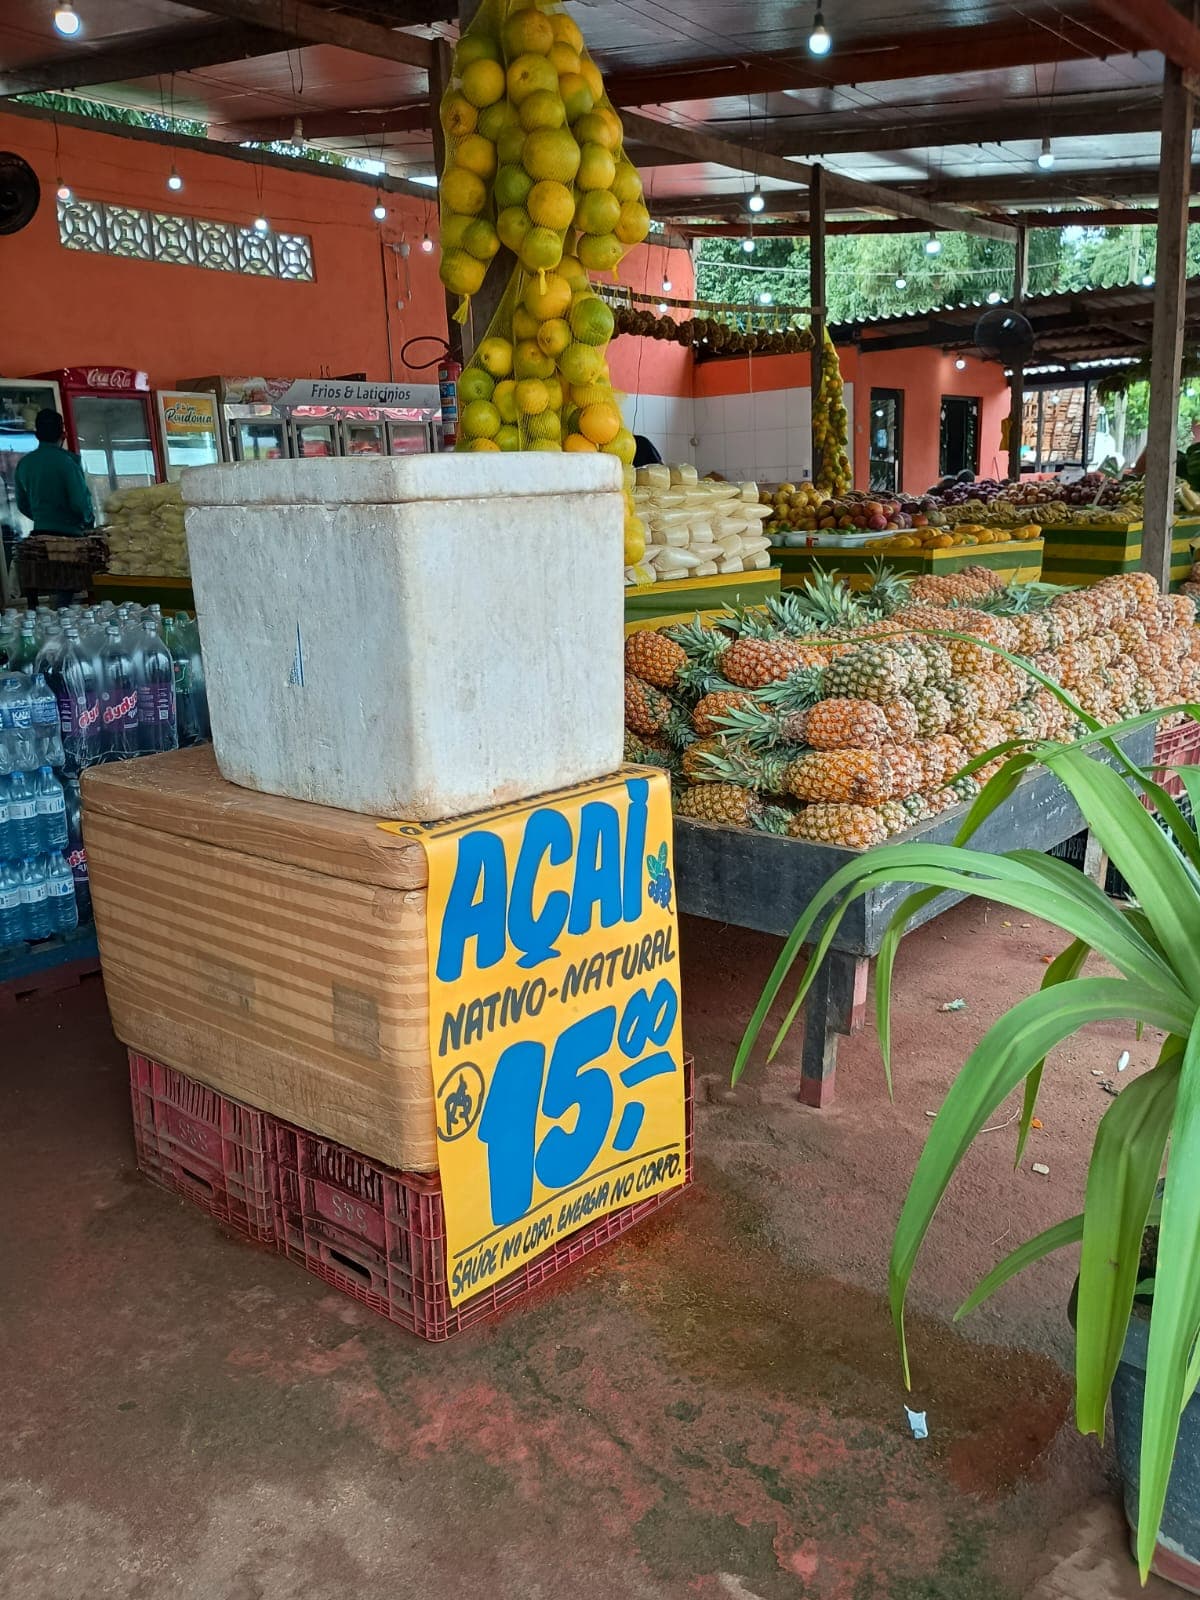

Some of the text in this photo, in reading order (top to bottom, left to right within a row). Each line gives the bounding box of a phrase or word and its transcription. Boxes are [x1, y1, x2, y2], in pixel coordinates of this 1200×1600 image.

[311, 384, 342, 399] Frios
[344, 385, 354, 399] &
[436, 778, 650, 983] AÇAÍ
[452, 1243, 500, 1298] SAÚDE
[500, 1231, 523, 1269] NO
[522, 1213, 555, 1254] COPO.
[609, 1172, 635, 1206] NO
[636, 1153, 682, 1193] CORPO.
